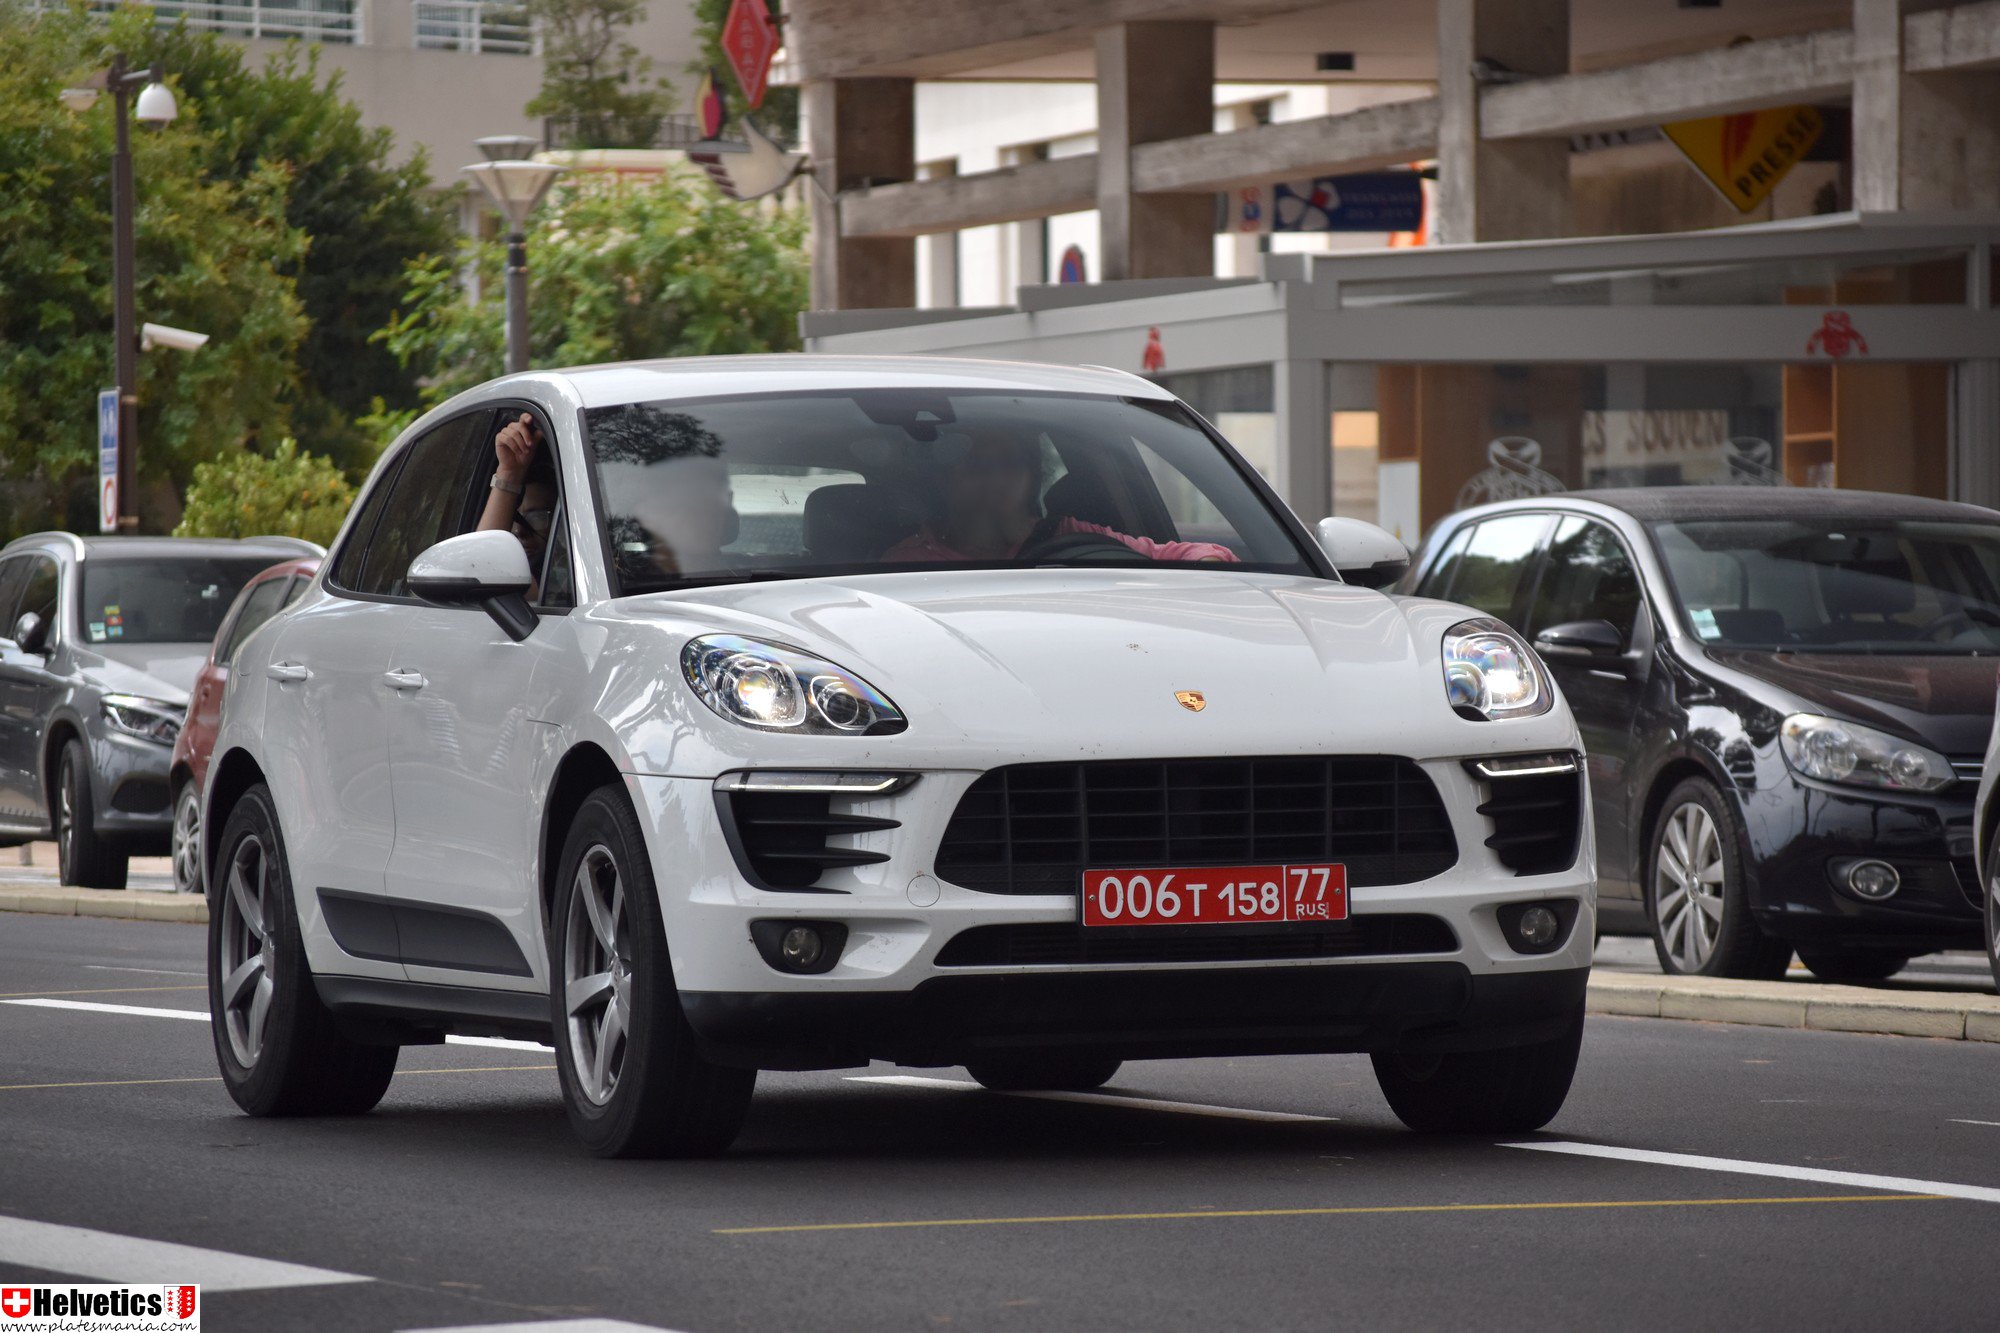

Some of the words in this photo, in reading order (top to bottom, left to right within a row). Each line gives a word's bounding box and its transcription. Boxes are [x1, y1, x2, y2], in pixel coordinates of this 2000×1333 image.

[739, 2, 755, 81] TABAC
[1735, 111, 1816, 197] PRESSE
[1290, 868, 1330, 902] 77
[1296, 903, 1326, 917] RUS
